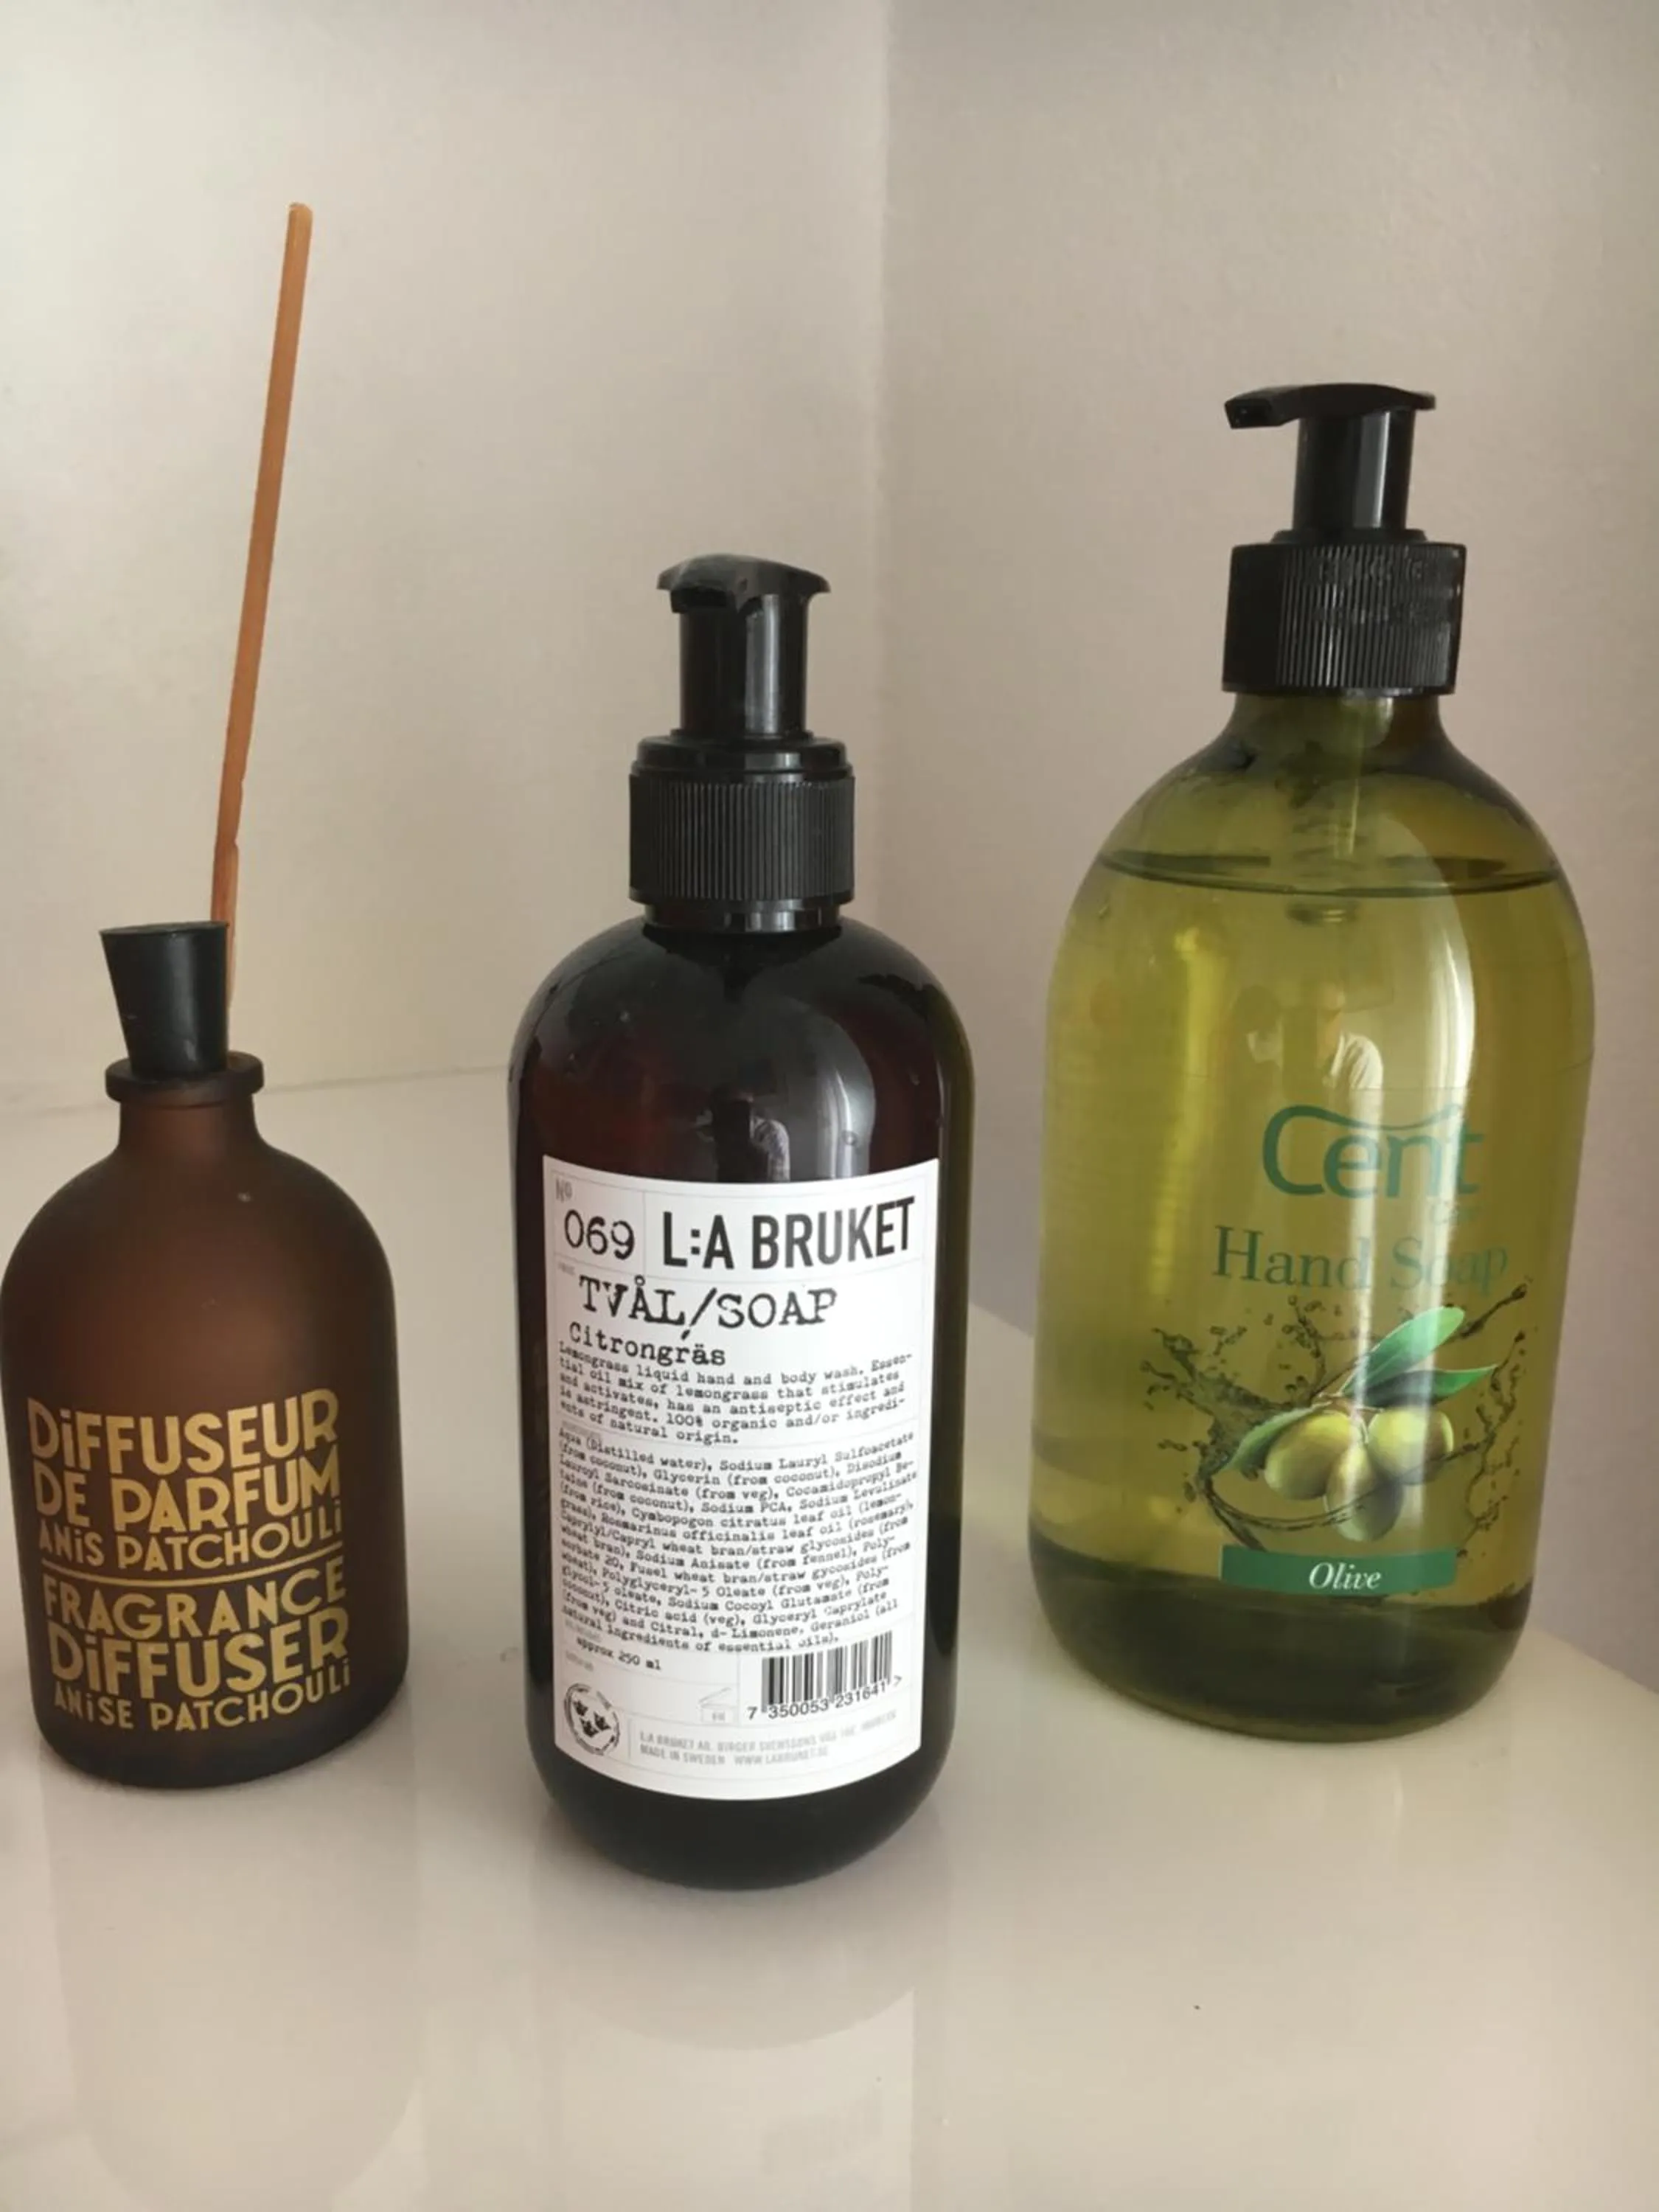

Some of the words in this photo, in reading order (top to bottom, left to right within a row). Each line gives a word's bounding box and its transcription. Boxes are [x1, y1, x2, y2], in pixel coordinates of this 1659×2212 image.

[1262, 1104, 1484, 1199] Cent
[565, 1209, 635, 1259] 069
[664, 1211, 734, 1269] L:A
[752, 1196, 915, 1270] BRUKET
[1214, 1225, 1371, 1290] Hand
[1390, 1236, 1508, 1298] Soap
[580, 1275, 838, 1340] TVÅL/SOAP
[560, 1340, 629, 1373] Lemongrass
[637, 1364, 689, 1382] liquid
[697, 1372, 735, 1385] hand
[743, 1374, 772, 1385] and
[781, 1371, 816, 1384] body
[824, 1366, 864, 1380] wash.
[871, 1354, 912, 1372] Essen-
[568, 1321, 726, 1366] Citrongräs
[560, 1357, 584, 1374] tial
[591, 1370, 611, 1383] oil
[619, 1377, 644, 1391] mix
[650, 1384, 668, 1394] of
[677, 1383, 768, 1402] lemongrass
[778, 1387, 813, 1398] that
[821, 1371, 900, 1394] stimulates
[560, 1373, 578, 1387] and
[667, 1400, 695, 1412] has
[703, 1404, 721, 1413] an
[729, 1400, 821, 1416] antiseptic
[829, 1391, 877, 1408] effect
[884, 1381, 905, 1397] and
[560, 1386, 571, 1398] is
[577, 1394, 658, 1422] astringent.
[667, 1413, 703, 1426] 100%
[712, 1416, 777, 1432] organic
[786, 1413, 839, 1428] and/or
[846, 1397, 905, 1420] ingredi-
[560, 1401, 585, 1417] ents
[590, 1413, 604, 1425] of
[611, 1420, 667, 1439] natural
[677, 1430, 739, 1446] origin.
[587, 1436, 654, 1464] (Distilled
[660, 1458, 712, 1471] water),
[720, 1458, 772, 1471] Sodium
[779, 1454, 827, 1470] Lauryl
[835, 1432, 914, 1462] Sulfoacetate
[654, 1469, 720, 1485] Glycerin
[727, 1473, 768, 1486] (from
[847, 1452, 902, 1473] Disodium
[34, 1461, 91, 1526] DE
[111, 1445, 341, 1534] PARFUM
[593, 1482, 624, 1500] (from
[630, 1494, 694, 1513] coconut),
[700, 1501, 754, 1514] Sodium
[761, 1502, 792, 1512] PCA,
[799, 1494, 848, 1509] Sodium
[605, 1472, 689, 1496] Sarcosinate
[695, 1486, 736, 1500] (from
[742, 1486, 779, 1501] veg),
[602, 1512, 676, 1538] Rosmarinus
[683, 1530, 775, 1542] officinalis
[783, 1526, 814, 1540] leaf
[820, 1522, 842, 1534] oil
[632, 1507, 713, 1528] Cymbopogon
[720, 1515, 787, 1528] citratus
[794, 1510, 824, 1524] leaf
[830, 1506, 852, 1519] oil
[663, 1542, 703, 1554] wheat
[711, 1543, 794, 1556] bran/straw
[800, 1529, 874, 1555] glycosides
[879, 1516, 908, 1534] (from
[630, 1561, 667, 1578] Fusel
[675, 1572, 714, 1582] wheat
[723, 1571, 806, 1583] bran/straw
[882, 1541, 911, 1560] (from
[636, 1550, 685, 1566] Sodium
[691, 1558, 750, 1570] Anisate
[757, 1558, 796, 1570] (from
[1309, 1562, 1381, 1590] Olive
[43, 1557, 346, 1639] FRAGRANCE
[615, 1599, 658, 1618] Citric
[665, 1610, 697, 1623] acid
[753, 1609, 817, 1624] Glyceryl
[824, 1591, 887, 1615] Caprylate
[668, 1597, 718, 1610] Sodium
[725, 1599, 773, 1612] Cocoyl
[781, 1589, 852, 1609] Glutamate
[858, 1578, 889, 1595] (from
[716, 1586, 765, 1598] Oleate
[773, 1584, 811, 1597] (from
[622, 1617, 644, 1628] and
[811, 1610, 869, 1632] Geraniol
[875, 1599, 898, 1615] (all
[608, 1624, 689, 1649] ingredients
[695, 1641, 712, 1652] of
[718, 1638, 791, 1652] essential
[619, 1651, 640, 1666] 250
[646, 1659, 661, 1670] ml
